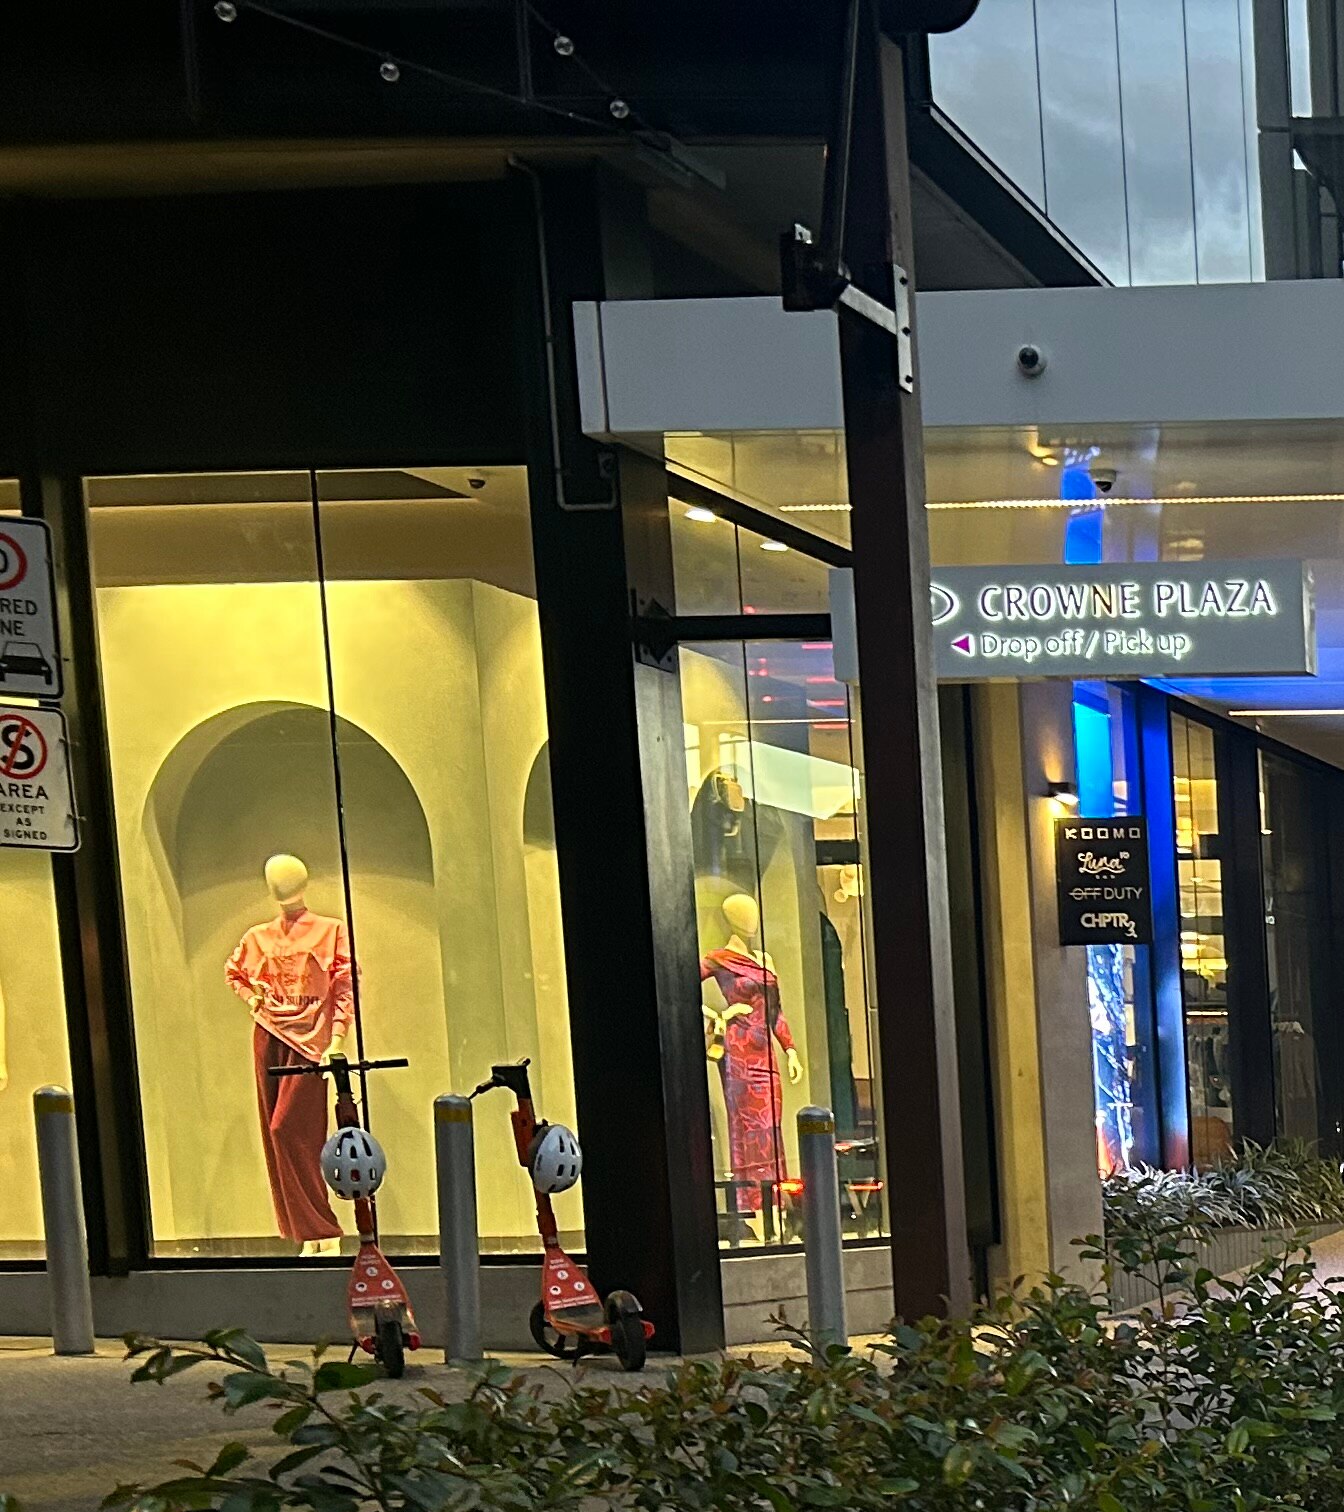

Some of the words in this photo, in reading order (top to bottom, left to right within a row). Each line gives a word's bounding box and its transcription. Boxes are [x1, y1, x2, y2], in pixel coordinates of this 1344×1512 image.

[980, 583, 1138, 620] CROWNE
[1154, 581, 1277, 618] PLAZA
[980, 633, 1039, 661] Drop
[1104, 629, 1153, 655] Pick
[1158, 635, 1192, 660] up
[0, 804, 45, 815] EXCEPT
[16, 817, 32, 827] AS
[4, 829, 48, 841] SIGNED
[1064, 828, 1141, 839] KOOMO
[1103, 887, 1143, 900] DUTY
